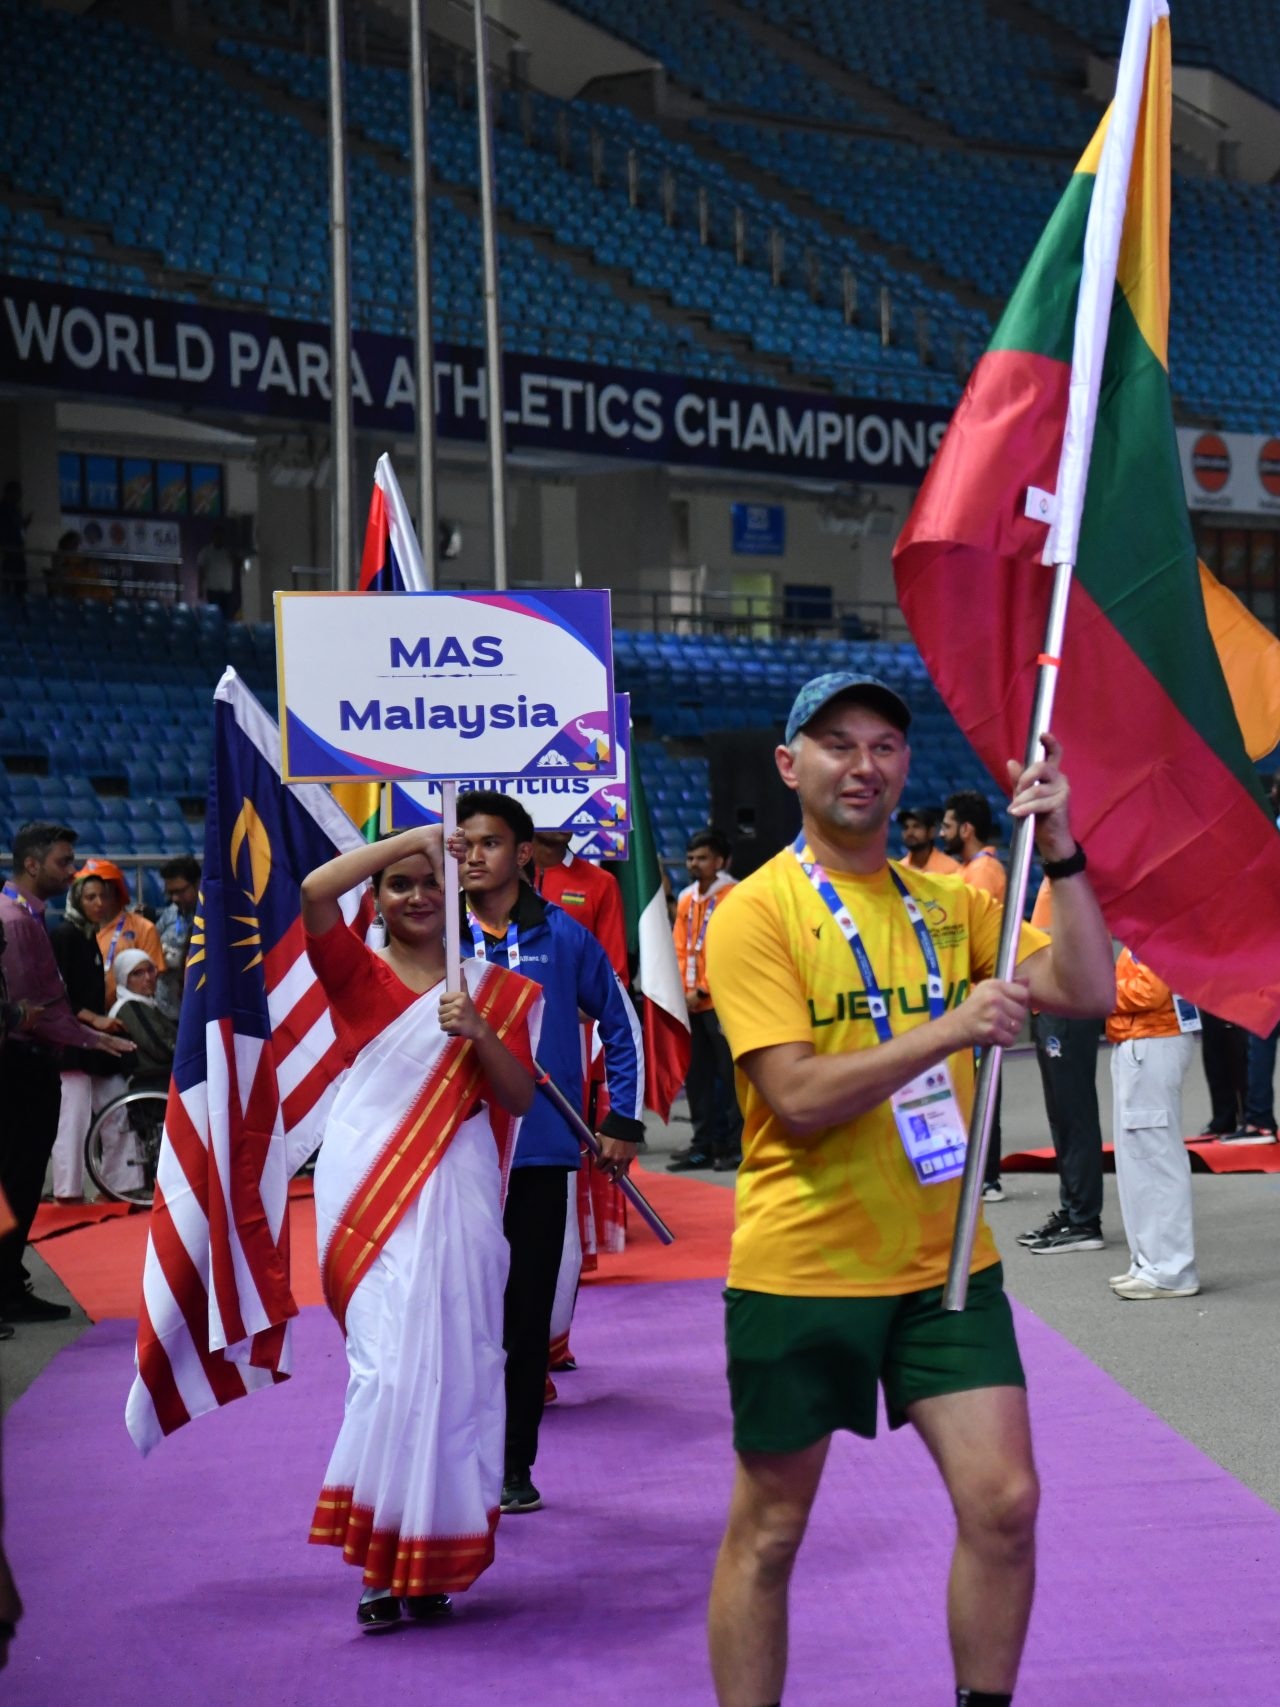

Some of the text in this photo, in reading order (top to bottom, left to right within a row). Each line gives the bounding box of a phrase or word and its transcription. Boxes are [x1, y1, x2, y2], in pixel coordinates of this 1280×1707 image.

[4, 296, 215, 383] WORLD
[384, 355, 663, 443] ATHETICS
[389, 635, 504, 668] MAS
[339, 694, 558, 740] Malaysia
[427, 778, 590, 795] auritius
